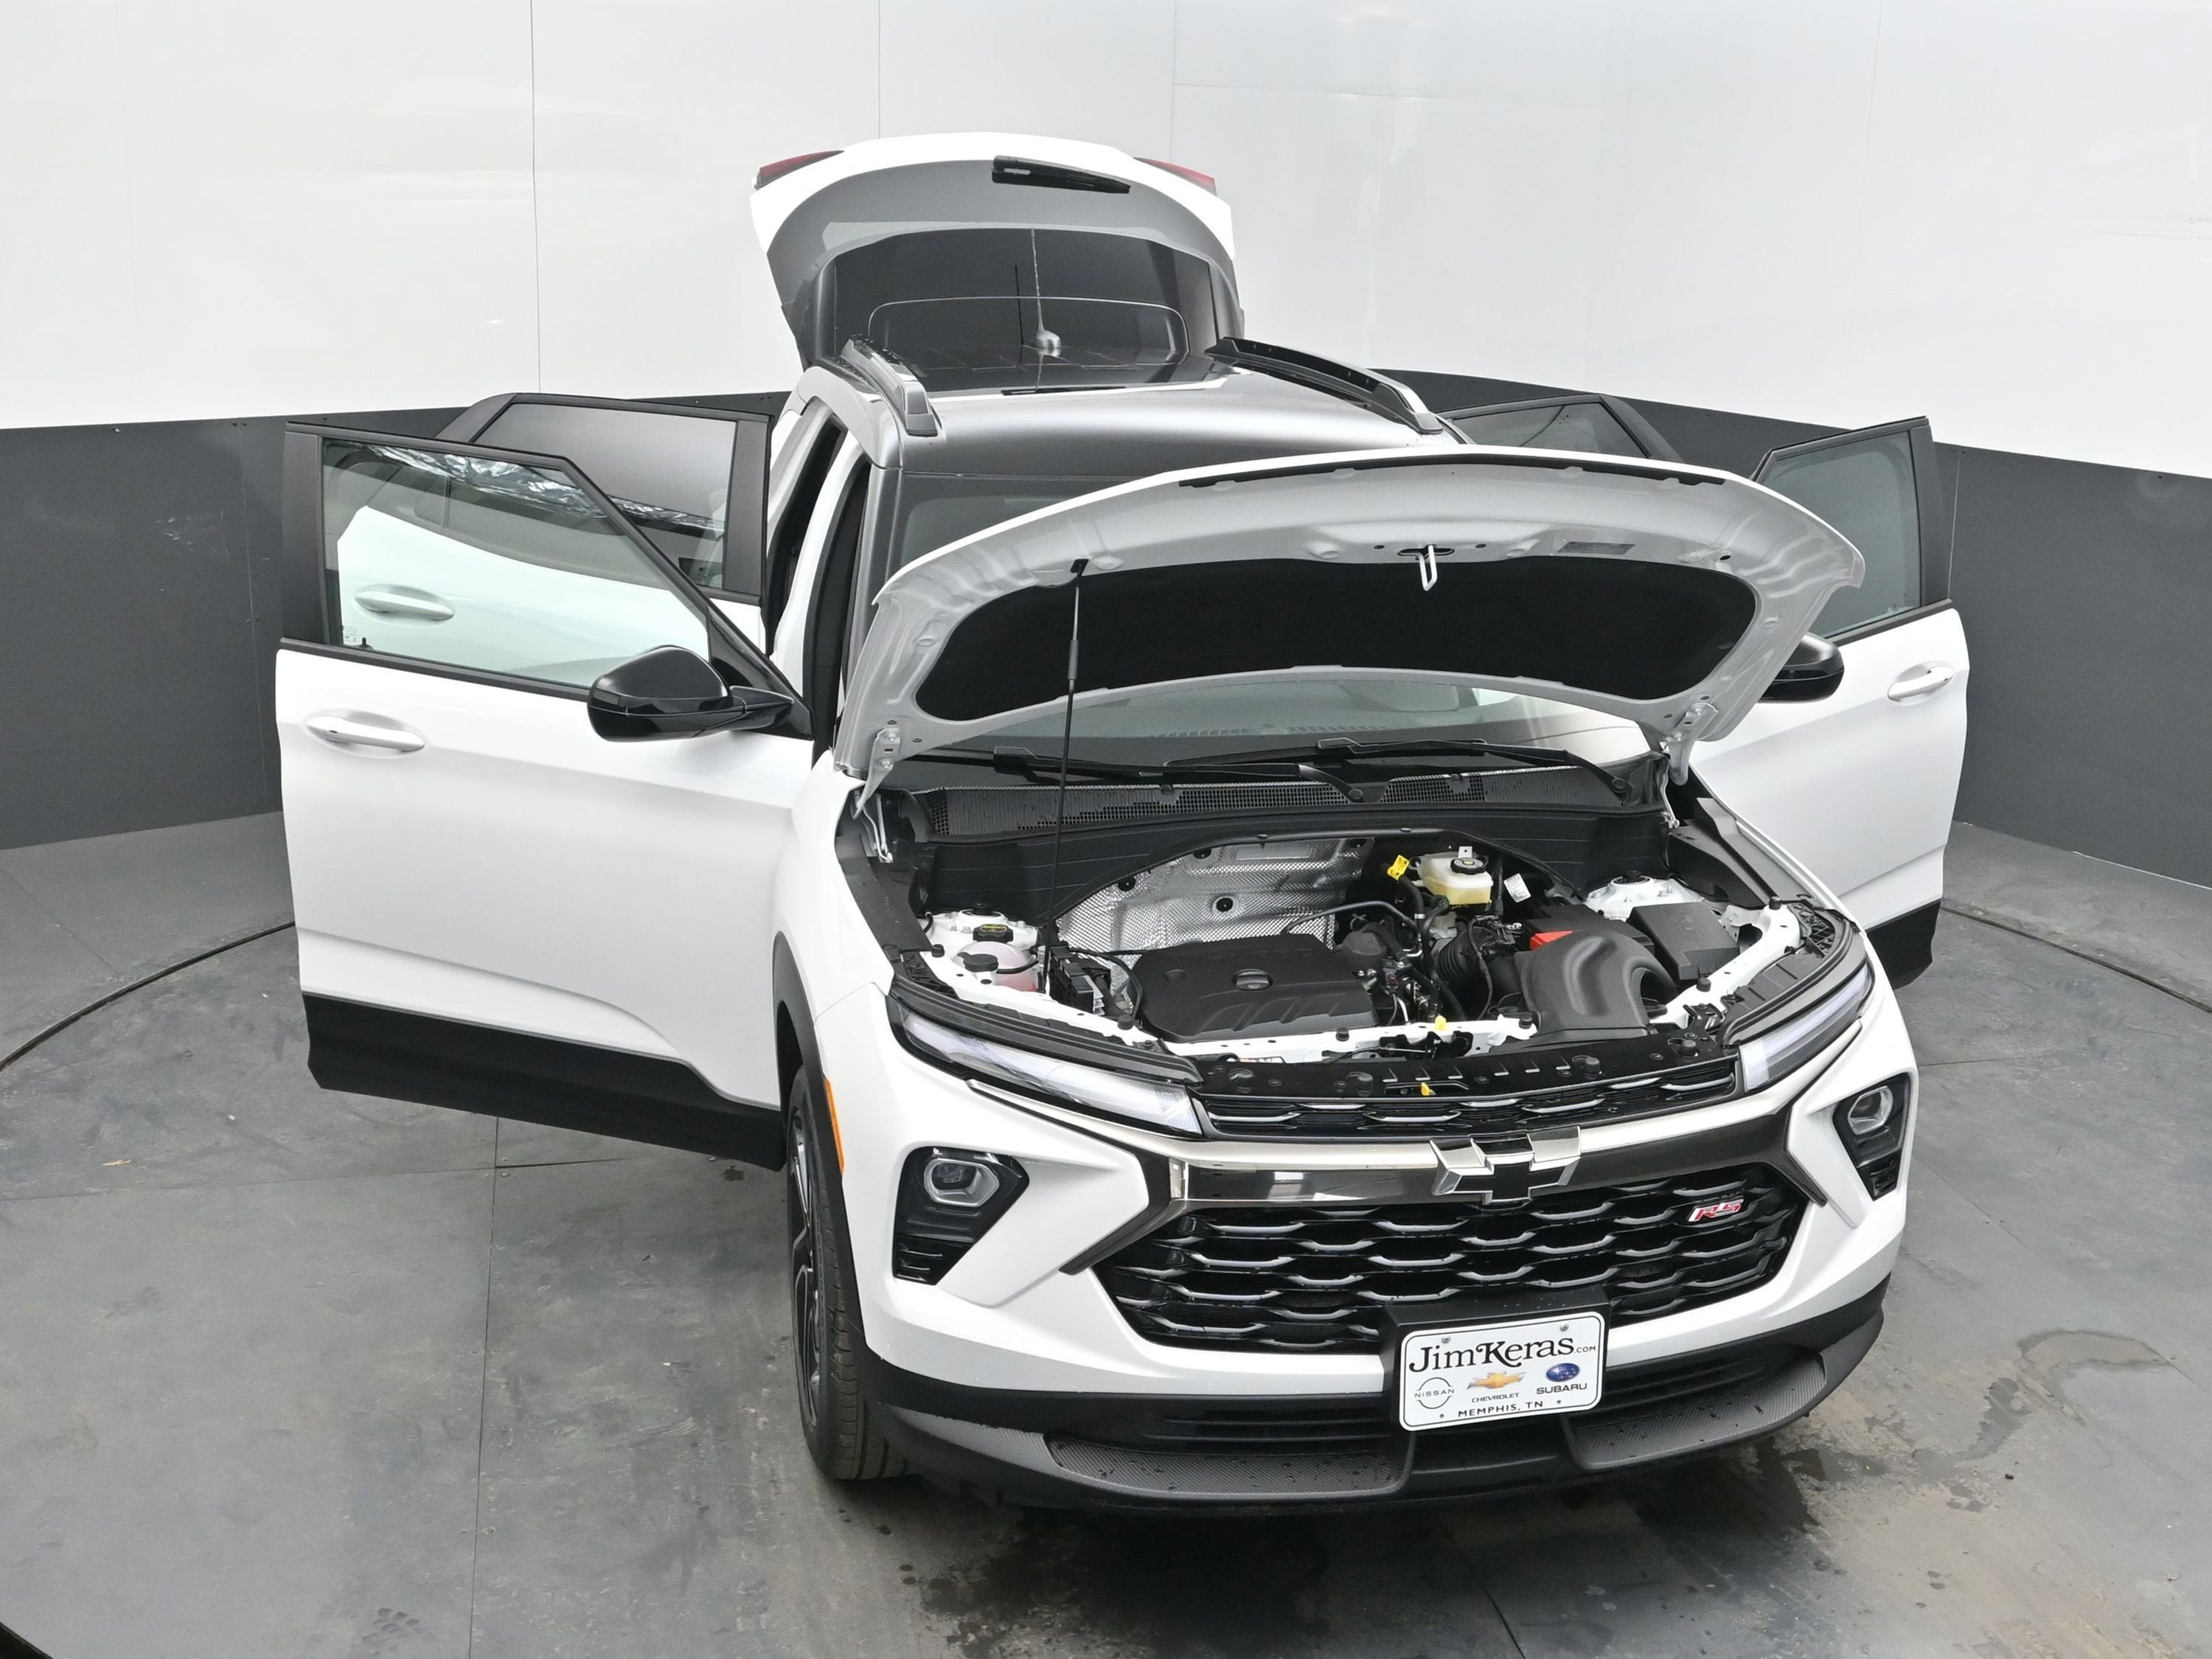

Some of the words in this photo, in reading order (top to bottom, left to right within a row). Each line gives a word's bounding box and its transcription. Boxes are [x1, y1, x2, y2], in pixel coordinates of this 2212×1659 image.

[1688, 1198, 1745, 1222] RS
[1414, 1388, 1455, 1398] NISSAN
[1536, 1382, 1587, 1395] SUBARU
[1471, 1392, 1520, 1403] CHEVROLET
[1525, 1400, 1543, 1410] TN
